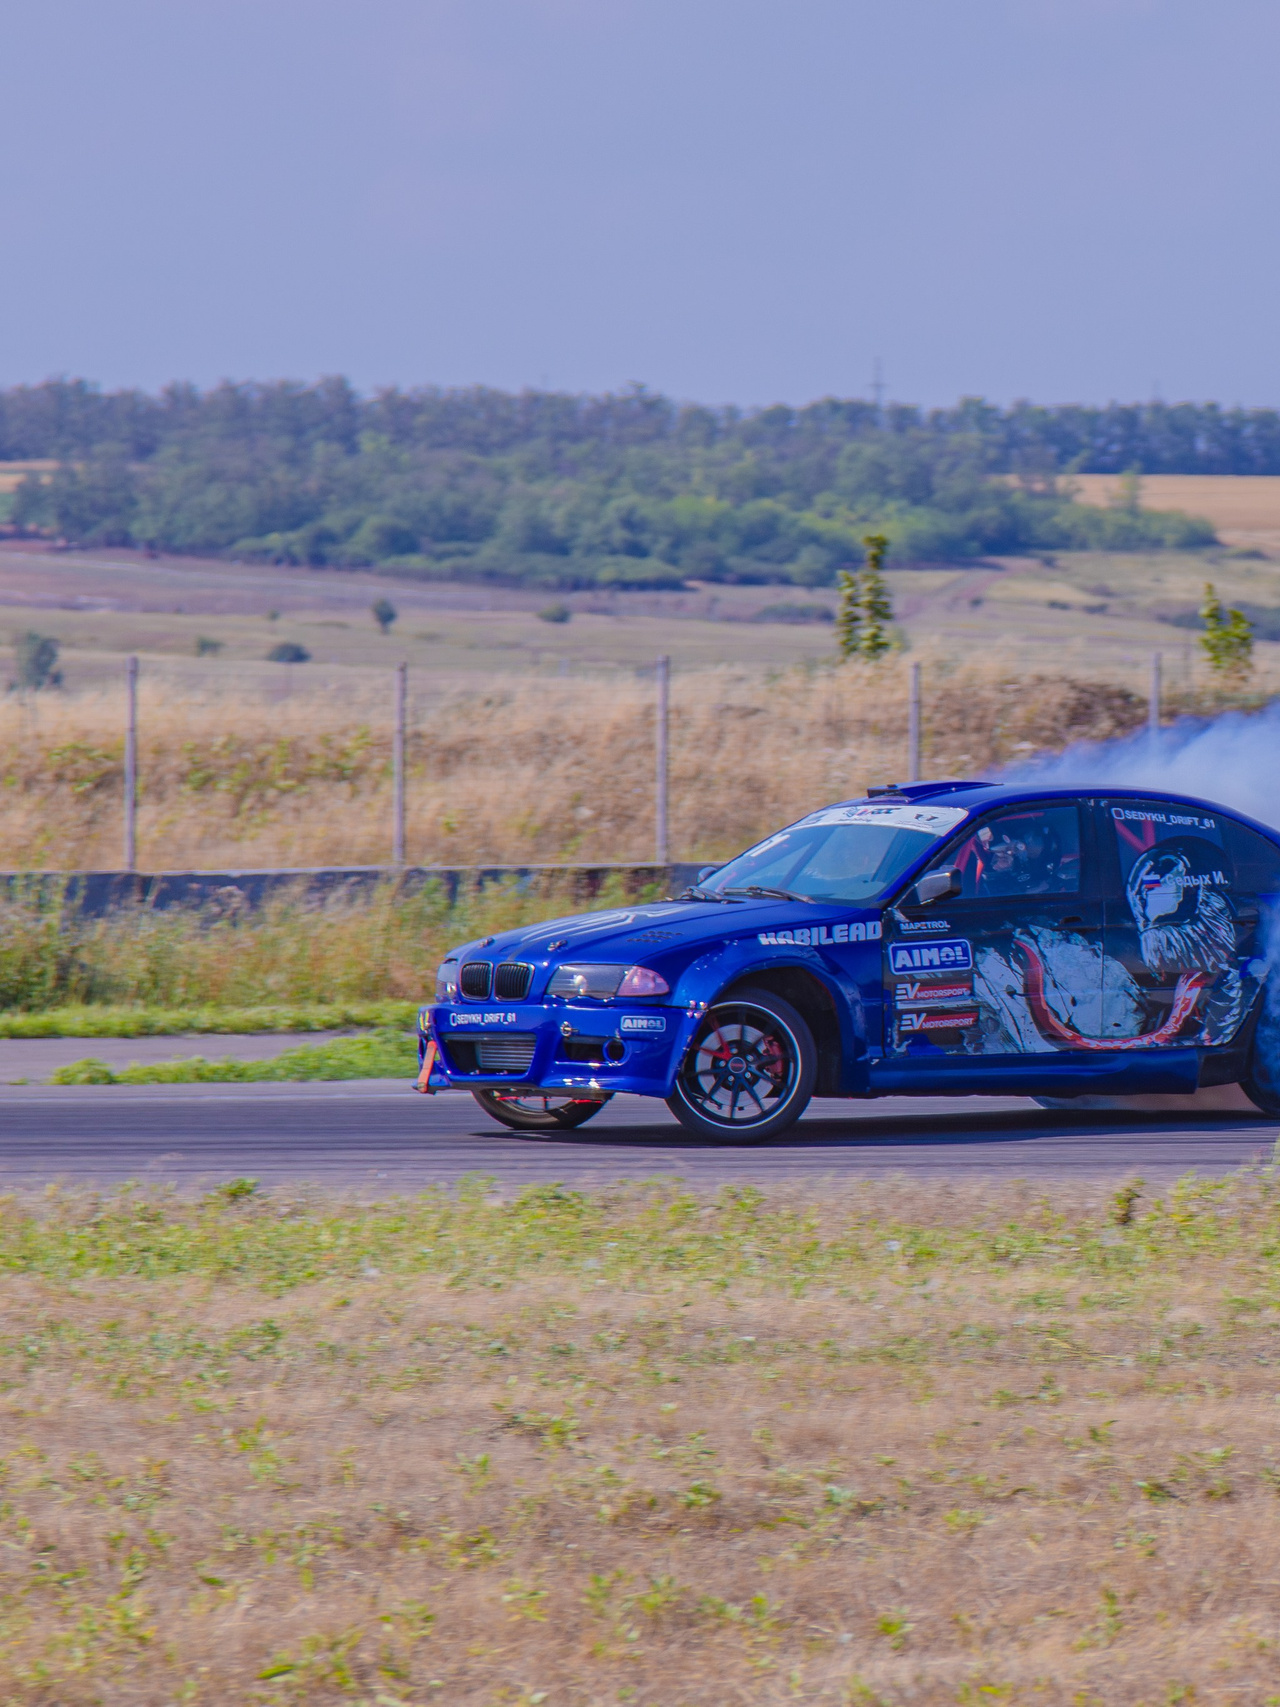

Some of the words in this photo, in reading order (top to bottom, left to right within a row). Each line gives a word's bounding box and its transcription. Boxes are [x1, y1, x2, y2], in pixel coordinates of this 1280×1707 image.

[895, 946, 968, 968] AIMOL
[623, 1018, 664, 1029] AIMOL
[922, 1018, 974, 1029] MOTORSPORT
